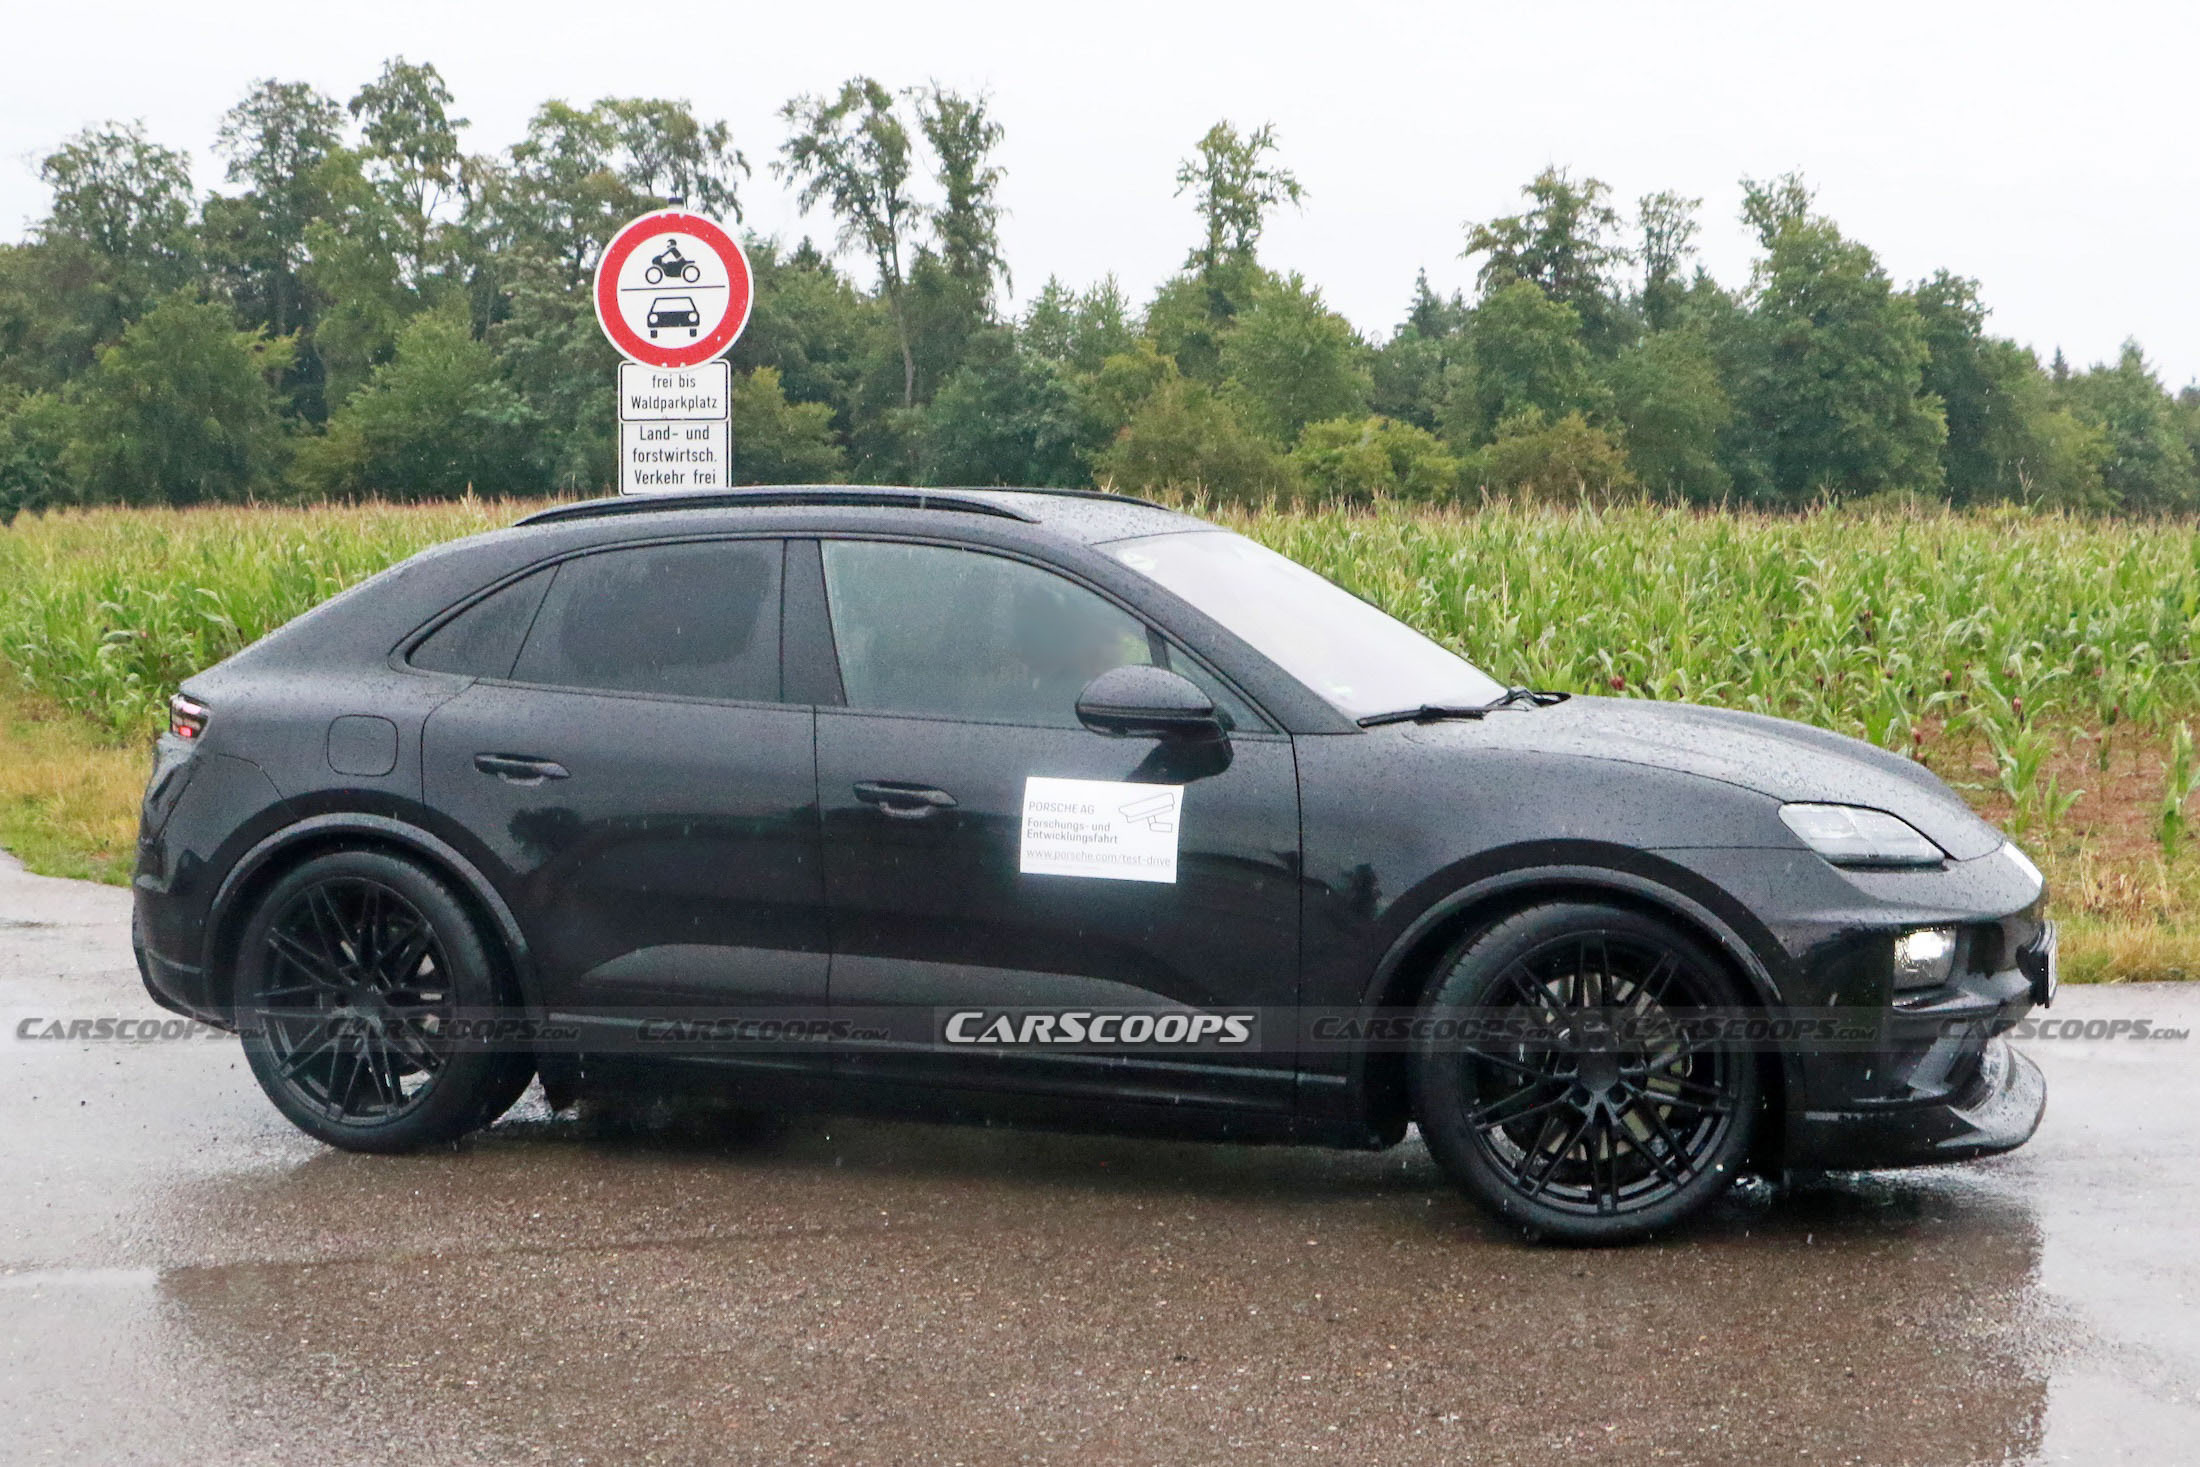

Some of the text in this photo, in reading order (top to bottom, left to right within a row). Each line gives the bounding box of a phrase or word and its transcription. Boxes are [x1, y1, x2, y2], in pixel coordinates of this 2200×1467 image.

[652, 374, 696, 389] frei bis
[631, 395, 718, 413] Waldparkplatz
[640, 425, 710, 441] Land- und
[633, 447, 718, 463] forstwirtsch.
[634, 469, 717, 485] Verkehr frei
[1028, 801, 1095, 815] PORSCHE AG
[1027, 817, 1111, 832] Forschungs- und
[1027, 828, 1119, 845] Entwicklungsfahrt
[1026, 849, 1172, 867] www.porsche.com/test-drive
